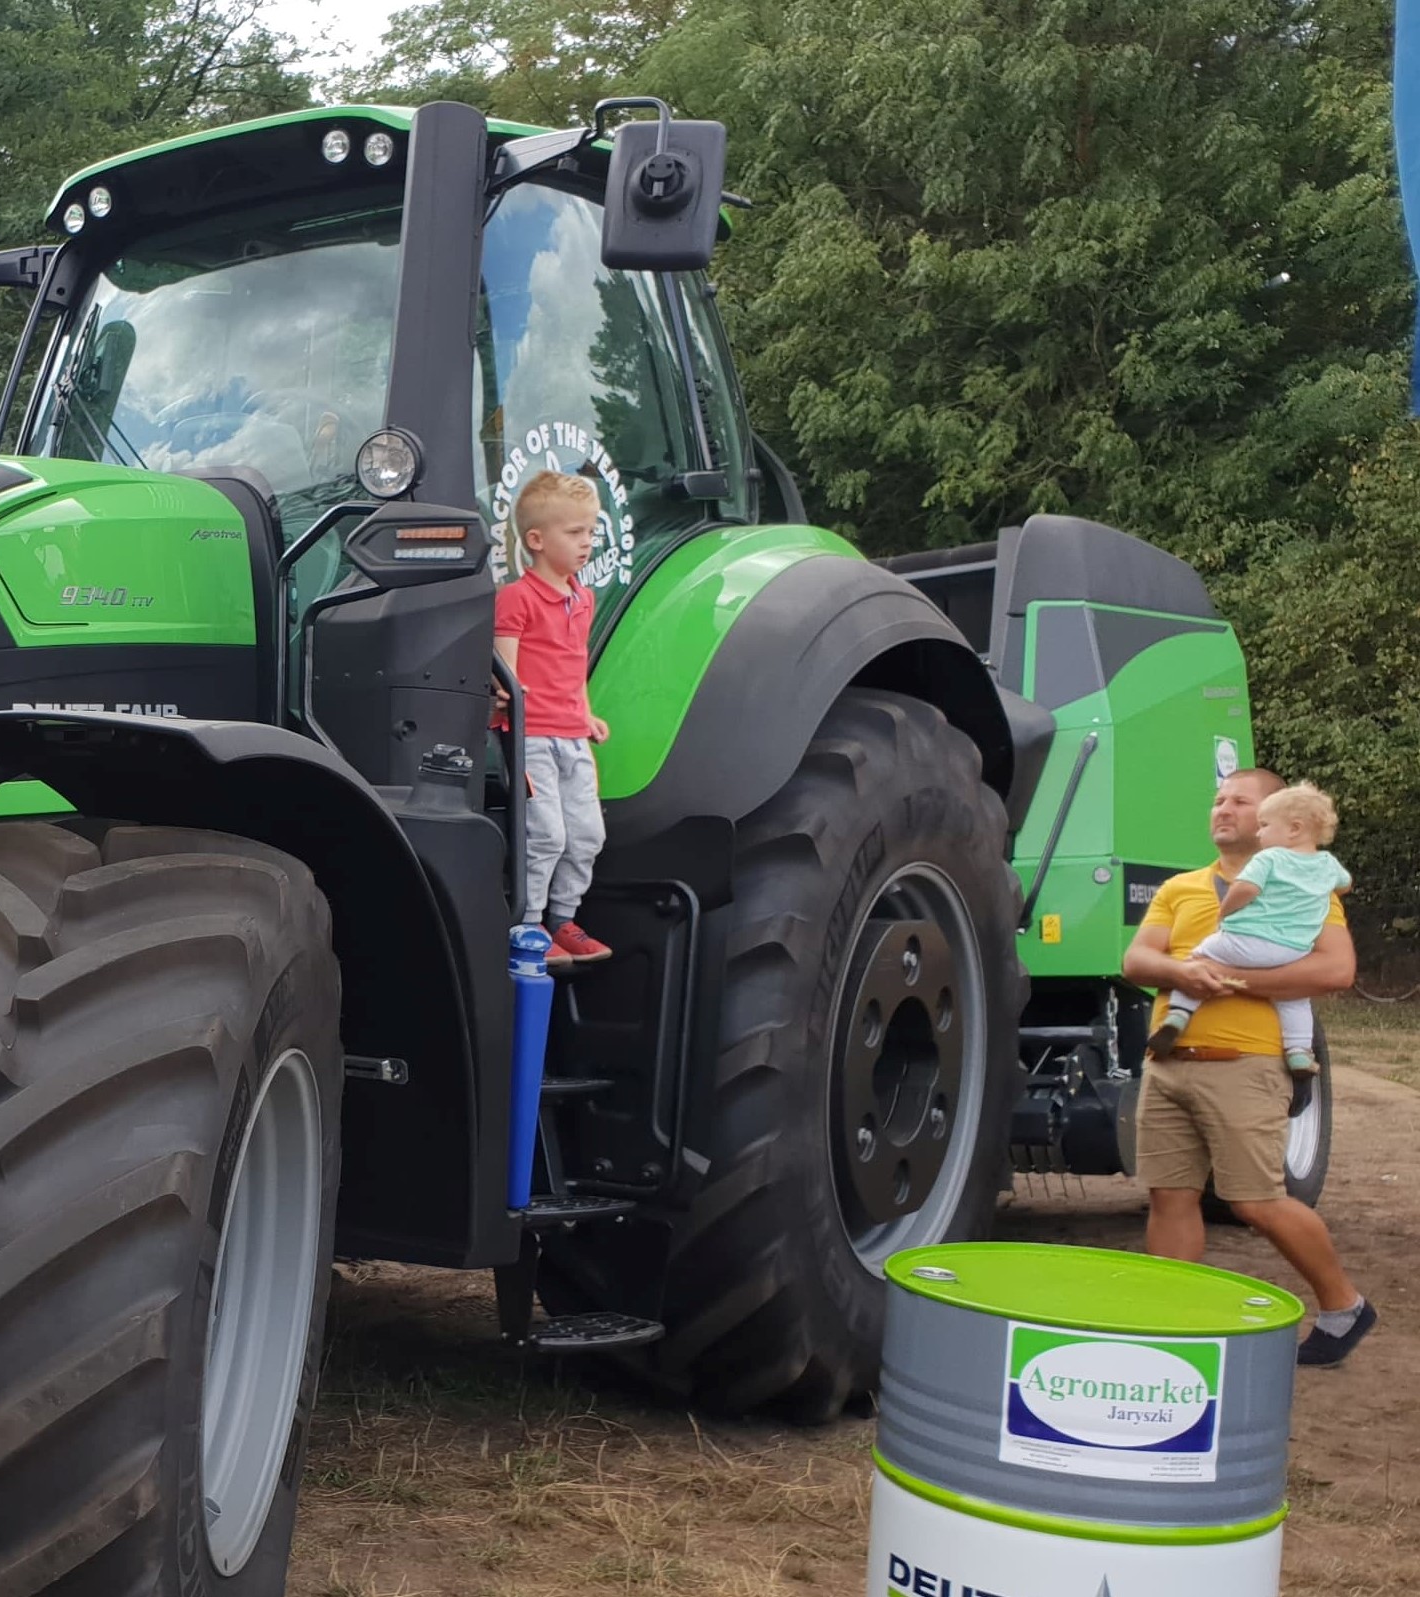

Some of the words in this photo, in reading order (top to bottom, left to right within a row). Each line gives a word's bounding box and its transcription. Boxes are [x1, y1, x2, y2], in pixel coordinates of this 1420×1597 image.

[490, 447, 528, 584] TRACTOR
[526, 423, 550, 454] OF
[553, 422, 587, 454] THE
[590, 438, 628, 509] YEAR
[619, 514, 635, 585] 2015
[190, 529, 243, 542] Agrotron
[578, 546, 621, 587] WINNER
[60, 586, 127, 606] 9340
[1024, 1366, 1205, 1402] Agromarket
[1106, 1405, 1173, 1426] Jaryszki
